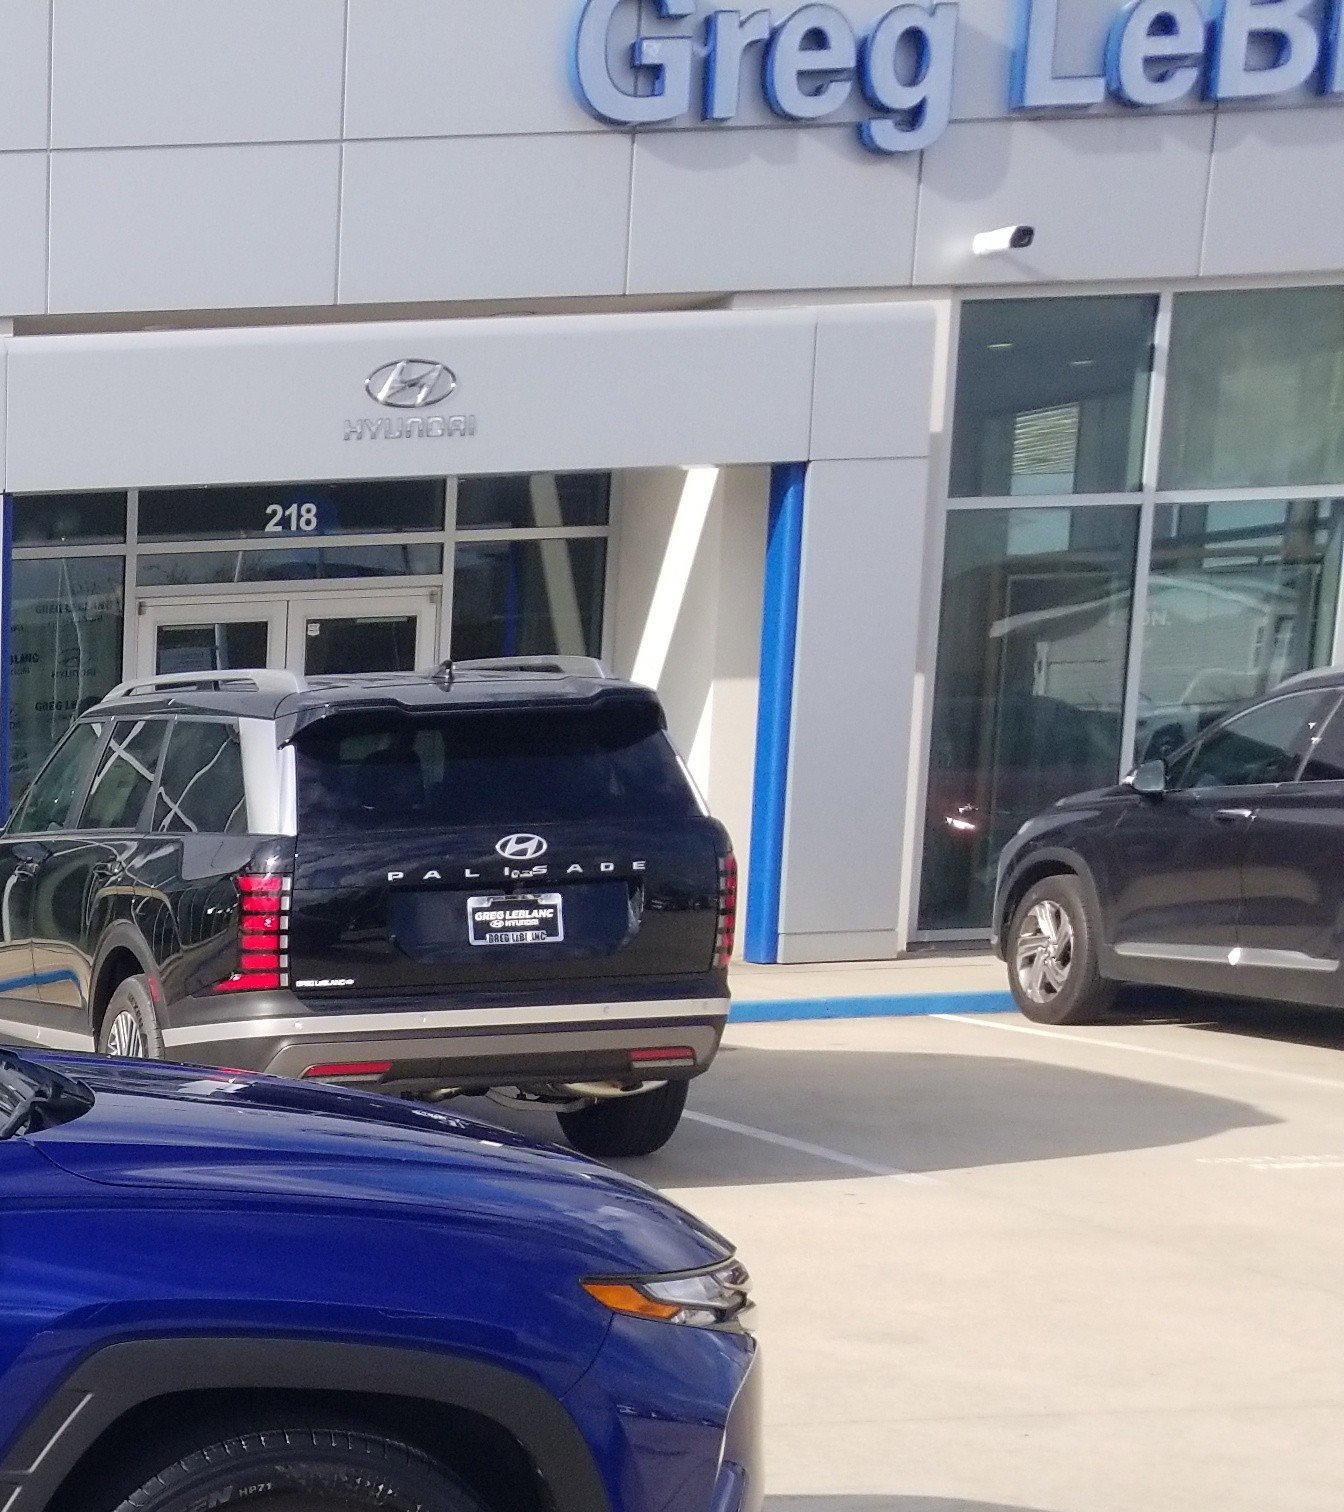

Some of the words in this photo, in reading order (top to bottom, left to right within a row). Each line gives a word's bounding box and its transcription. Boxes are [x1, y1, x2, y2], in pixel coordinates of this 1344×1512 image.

[568, 0, 960, 155] Greg
[1013, 0, 1344, 112] LeB
[343, 414, 477, 441] HYUNDAI
[264, 502, 318, 532] 218
[387, 860, 646, 882] PALISADE
[475, 911, 504, 921] GREG
[505, 908, 554, 920] LEBLANC
[239, 1482, 272, 1498] HP71
